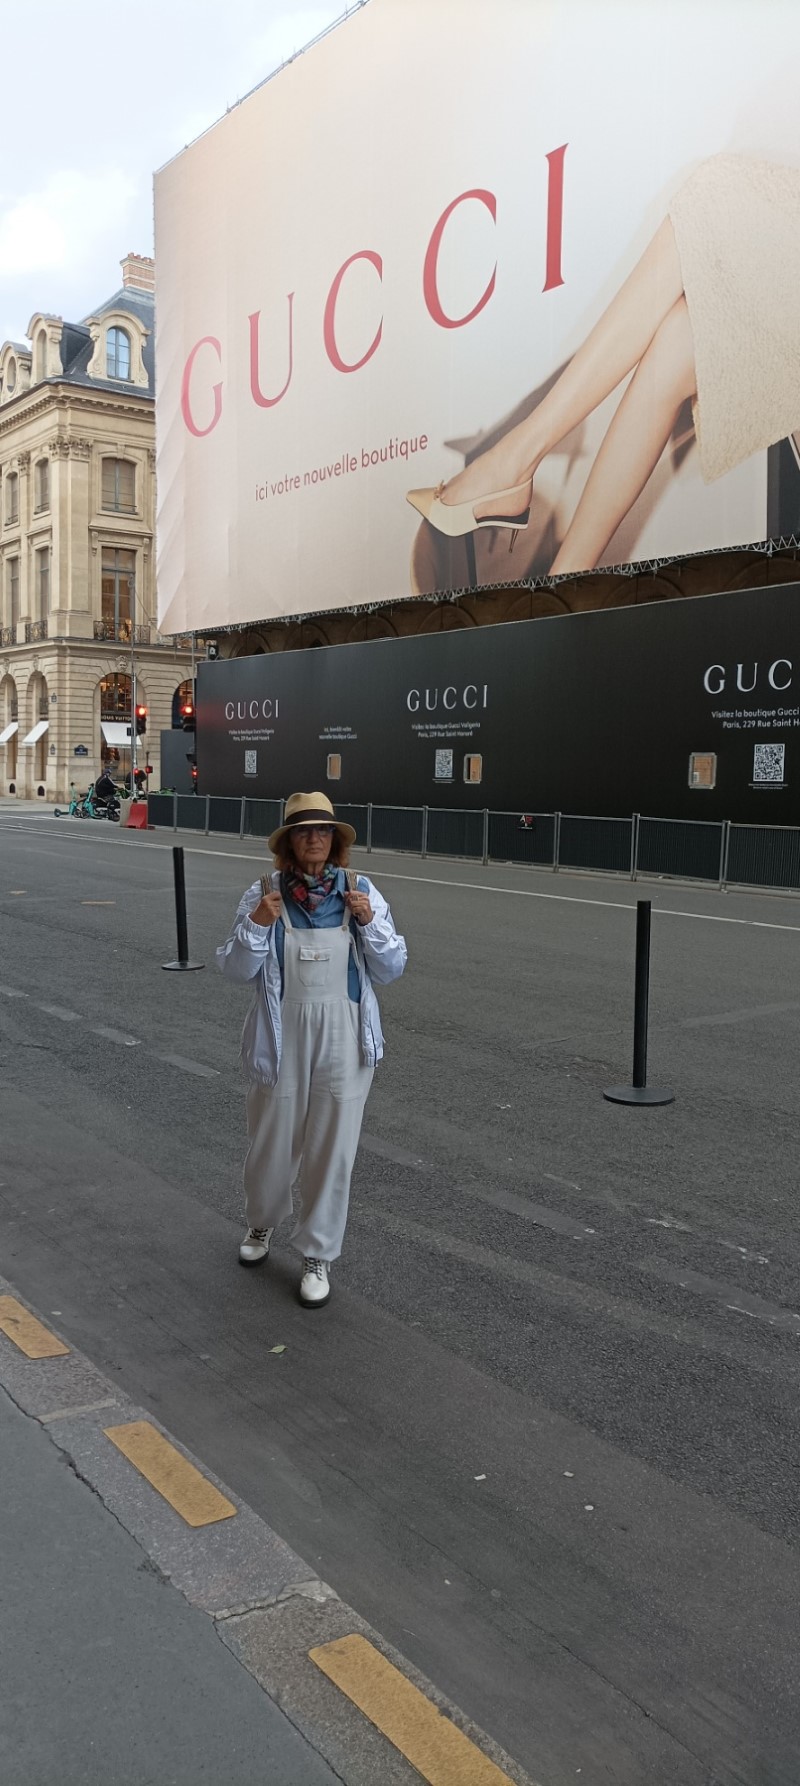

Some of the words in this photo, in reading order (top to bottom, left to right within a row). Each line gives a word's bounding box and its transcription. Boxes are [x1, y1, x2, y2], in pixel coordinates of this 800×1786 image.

[181, 143, 569, 438] GUCCI
[255, 481, 268, 502] ici
[271, 474, 301, 496] votre
[304, 453, 358, 486] nouvelle
[361, 434, 428, 469] boutique
[703, 659, 793, 694] GUC
[225, 699, 279, 720] GUCCI
[407, 684, 488, 712] GUCCI
[722, 721, 741, 729] Paris,
[743, 720, 755, 728] 229
[772, 719, 791, 727] Saint
[735, 709, 742, 718] la
[743, 708, 776, 718] boutique
[777, 707, 800, 716] Gucci
